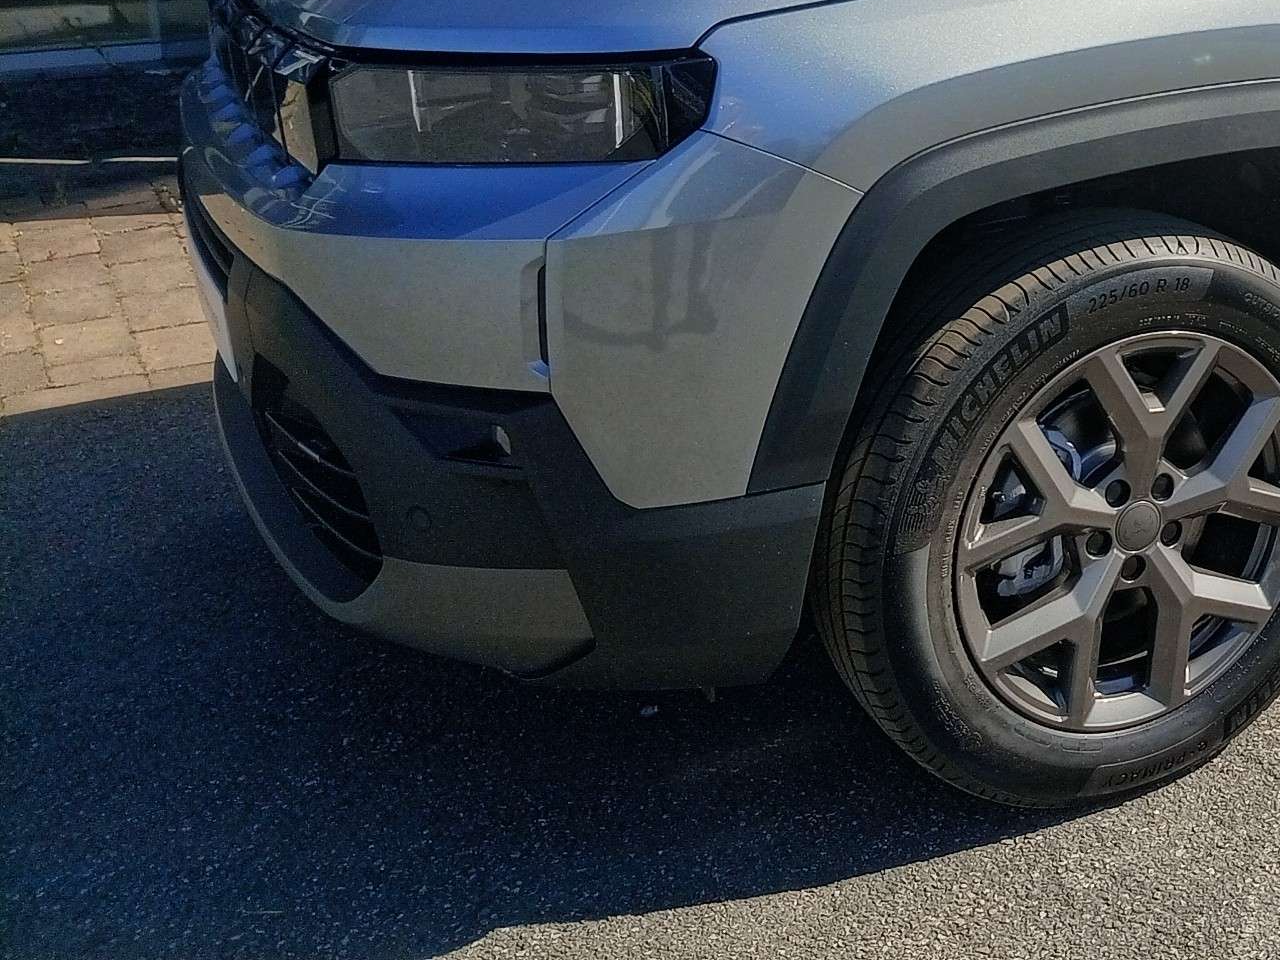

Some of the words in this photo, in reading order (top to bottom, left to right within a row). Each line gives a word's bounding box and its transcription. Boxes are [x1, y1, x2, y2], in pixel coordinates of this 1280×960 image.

[1087, 280, 1150, 313] 225/60
[1156, 278, 1169, 293] R
[1174, 277, 1191, 291] 18
[927, 302, 1068, 473] MICHELIN
